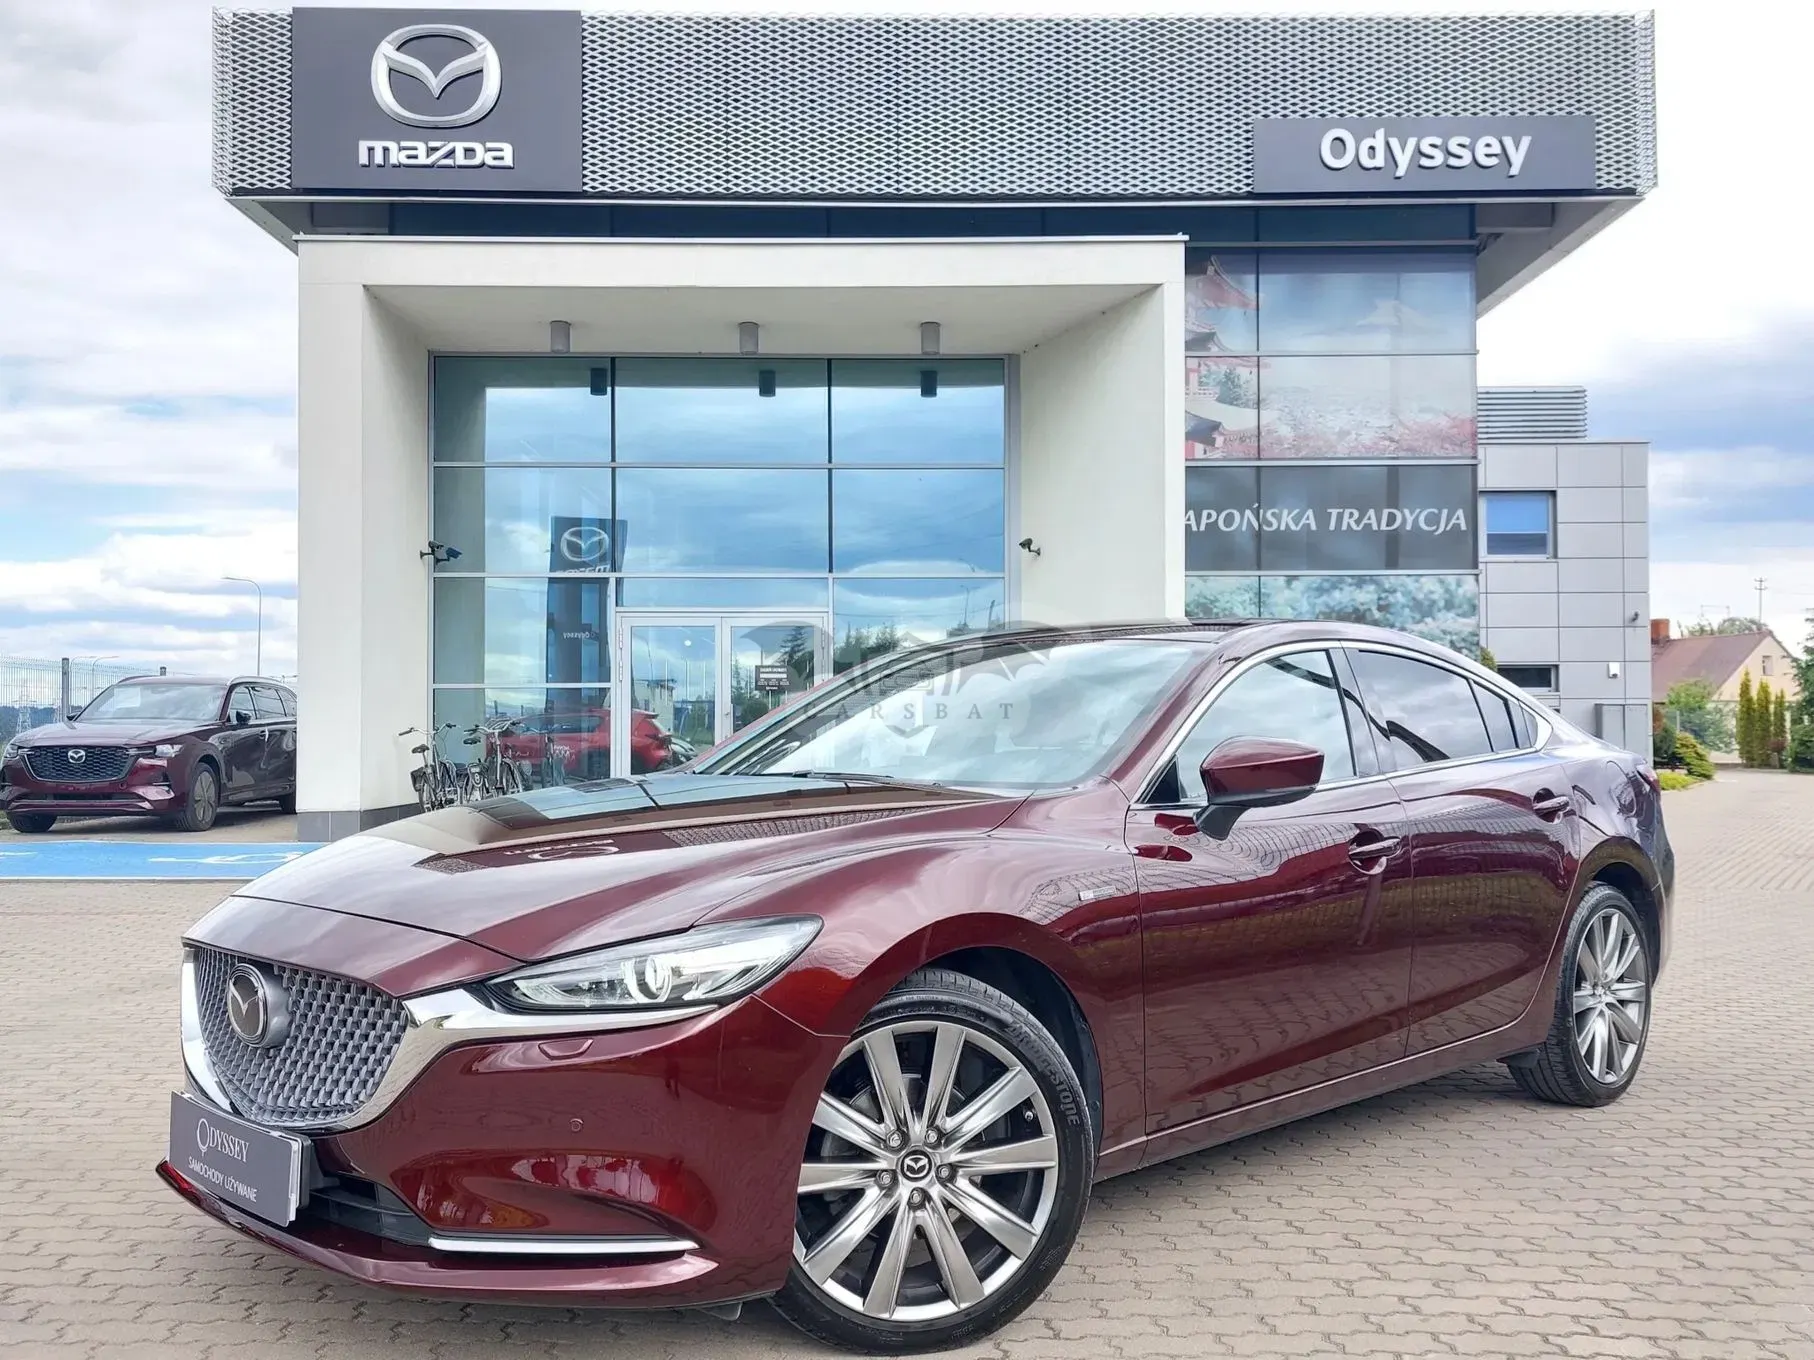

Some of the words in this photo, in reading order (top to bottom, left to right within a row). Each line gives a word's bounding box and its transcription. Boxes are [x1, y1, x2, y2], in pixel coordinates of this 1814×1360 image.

[358, 139, 514, 169] mazda
[1319, 127, 1532, 178] Odyssey
[1185, 502, 1318, 532] APOŃSKA
[1326, 507, 1468, 535] TRADYCJA
[196, 1118, 250, 1163] ODYSSEY
[188, 1156, 225, 1186] SAMOCHODY
